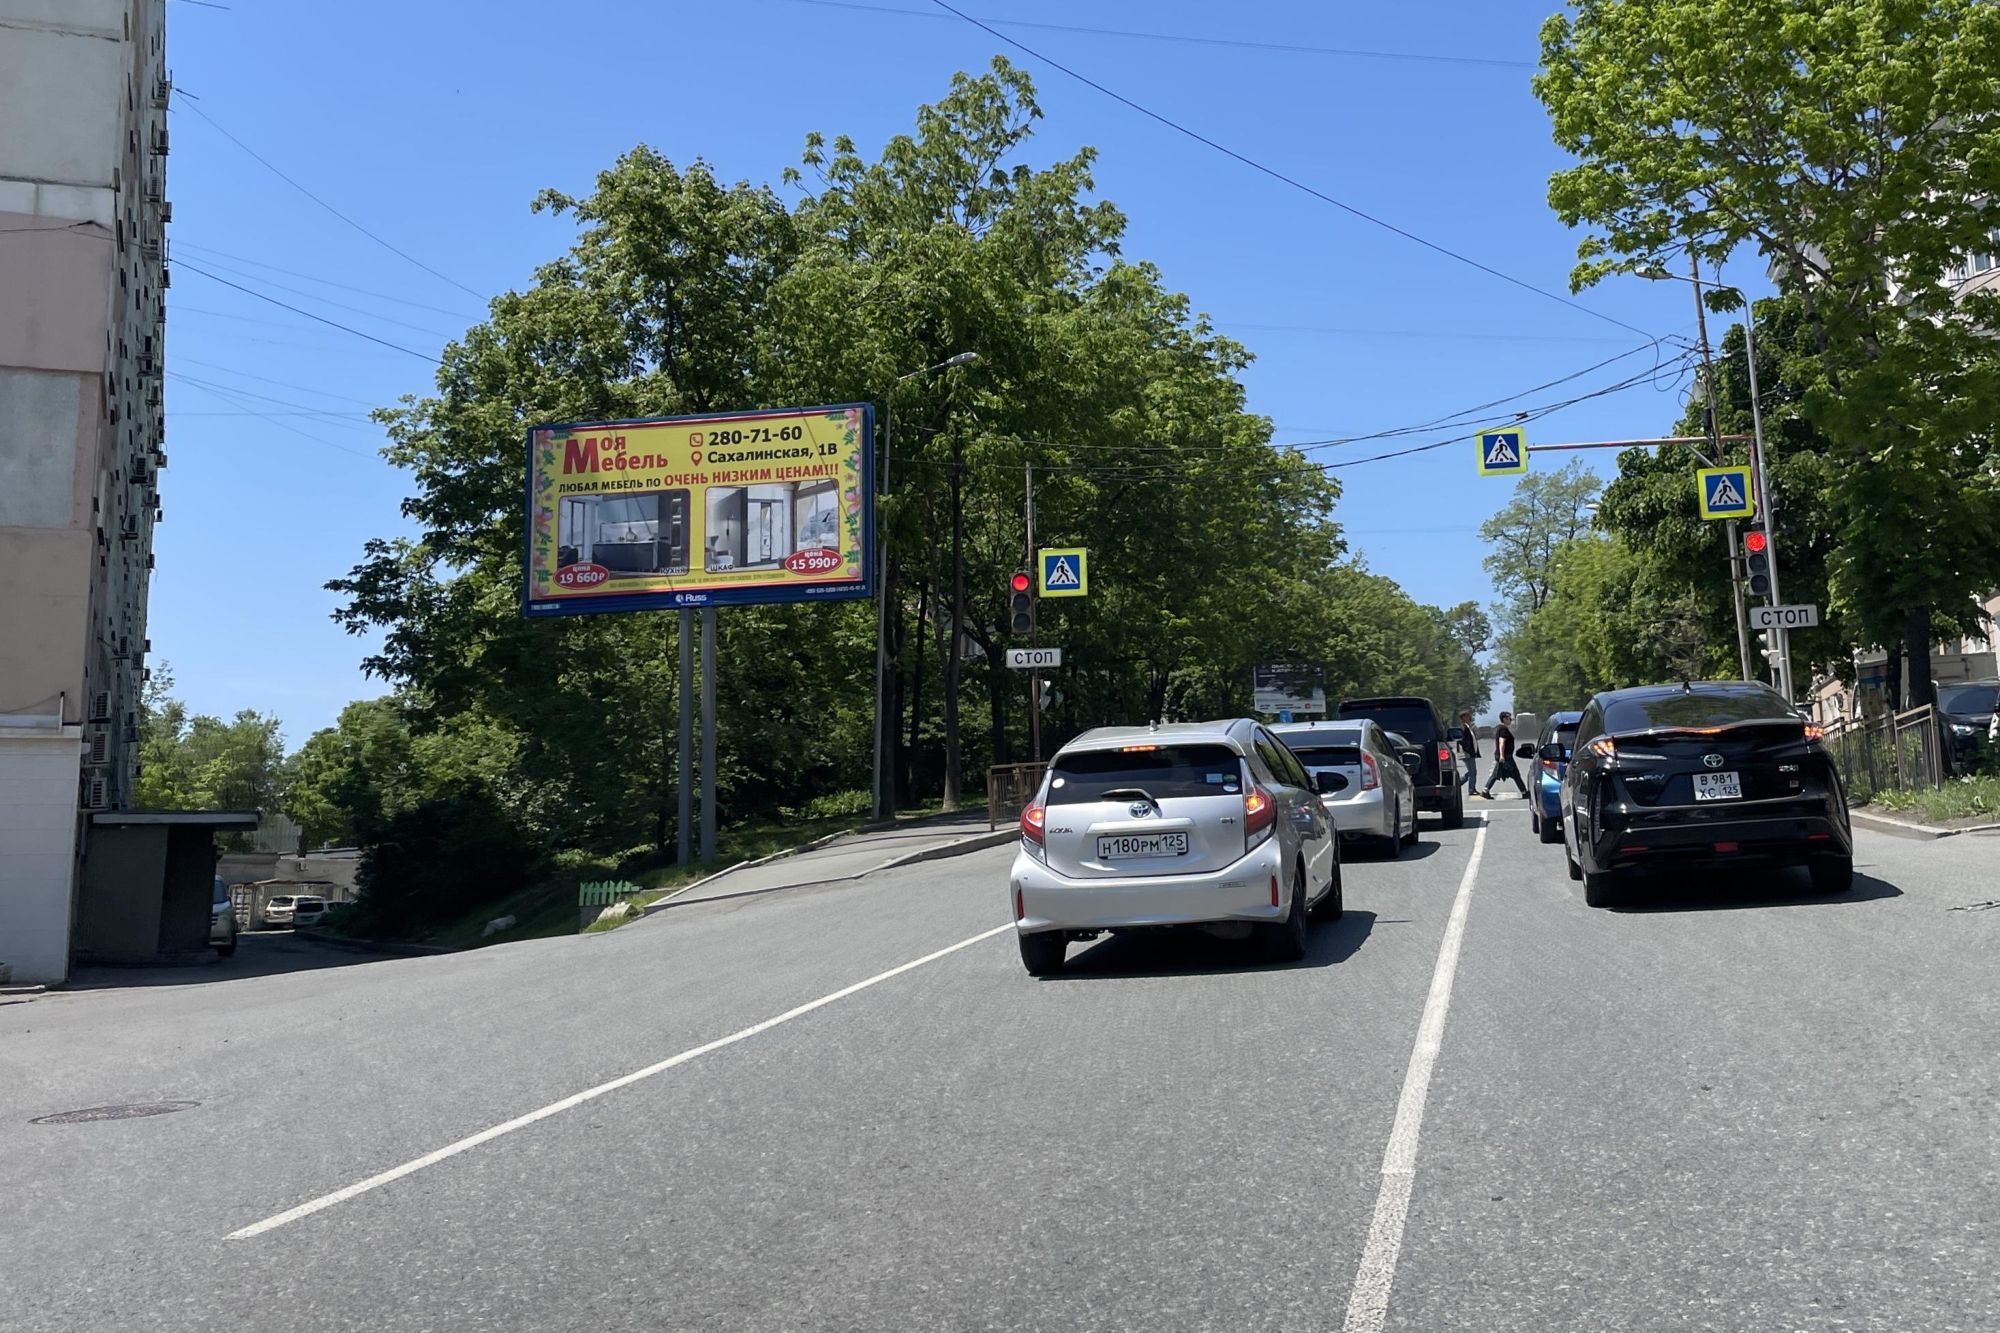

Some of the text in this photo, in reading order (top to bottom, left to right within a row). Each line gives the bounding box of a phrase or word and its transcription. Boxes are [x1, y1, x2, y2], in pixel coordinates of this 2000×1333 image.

[709, 426, 802, 446] 280-71-60
[708, 443, 838, 464] Сахалинская, 1В
[558, 463, 838, 493] ЛЮБАЯ МЕБЕЛЬ ПО ОЧЕНЬ НИЗКИМ ЦЕНАМ!!!
[710, 564, 733, 572] ШКАФ
[791, 559, 807, 570] 15
[559, 574, 573, 584] 19
[685, 593, 707, 603] Russ
[1760, 609, 1810, 625] СТОП
[1014, 652, 1053, 665] СТОП
[1711, 773, 1733, 784] 981
[1722, 785, 1738, 795] 125
[1161, 835, 1184, 847] 125
